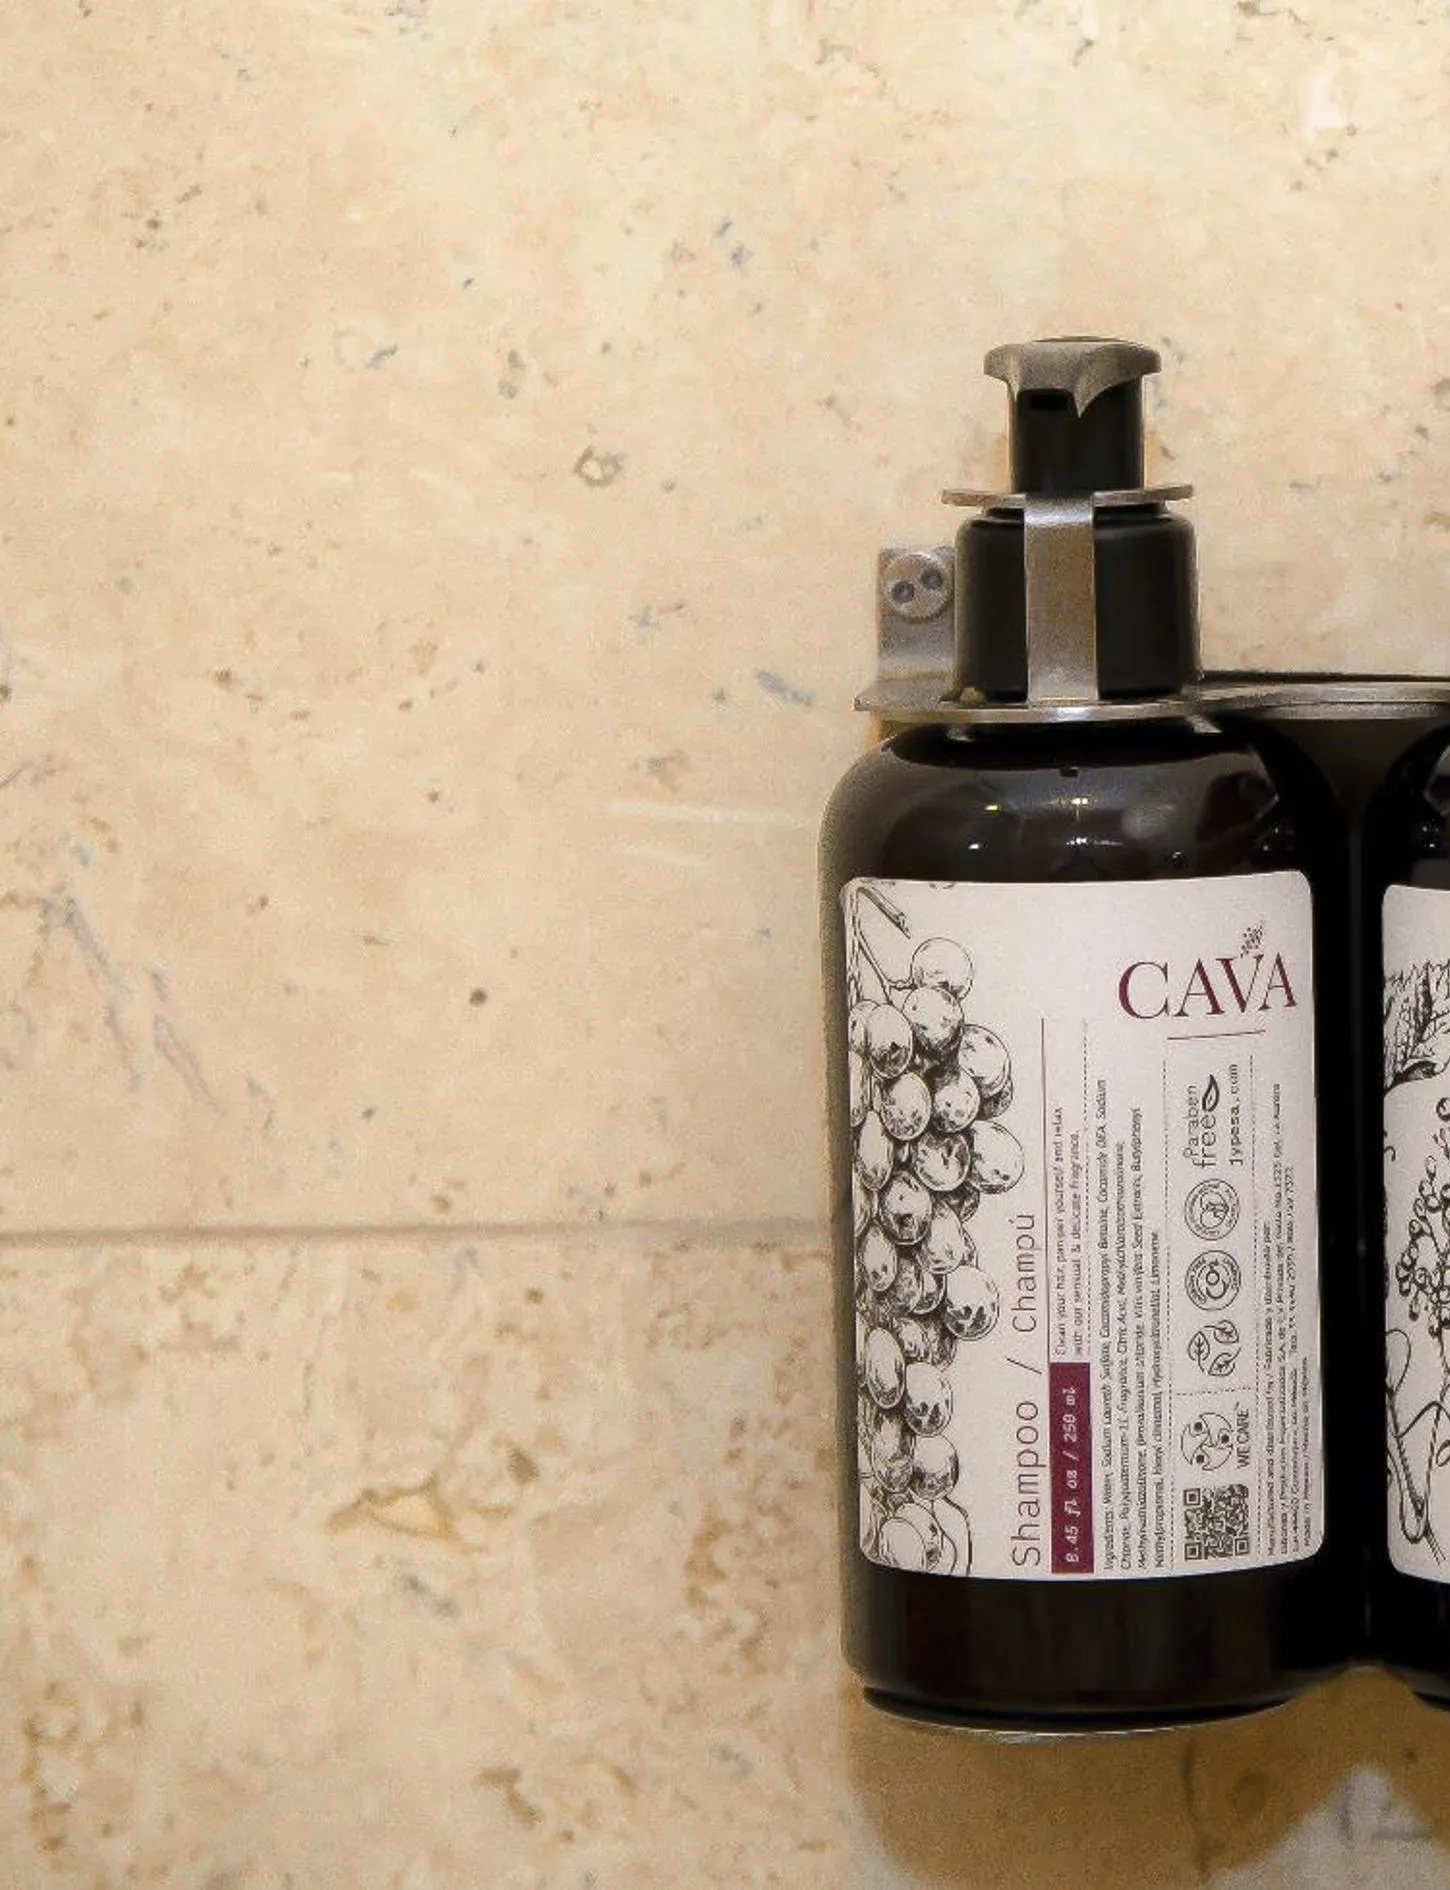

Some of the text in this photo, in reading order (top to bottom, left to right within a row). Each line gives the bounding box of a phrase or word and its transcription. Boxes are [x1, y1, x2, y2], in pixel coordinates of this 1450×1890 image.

[1119, 952, 1297, 1019] CAVA
[1182, 1085, 1199, 1158] Paraben
[1192, 1114, 1216, 1169] free
[1006, 1213, 1046, 1566] Shampoo / Champú
[1062, 1386, 1080, 1563] 8.45 fl oz / 250 ml
[1237, 1445, 1250, 1469] WE
